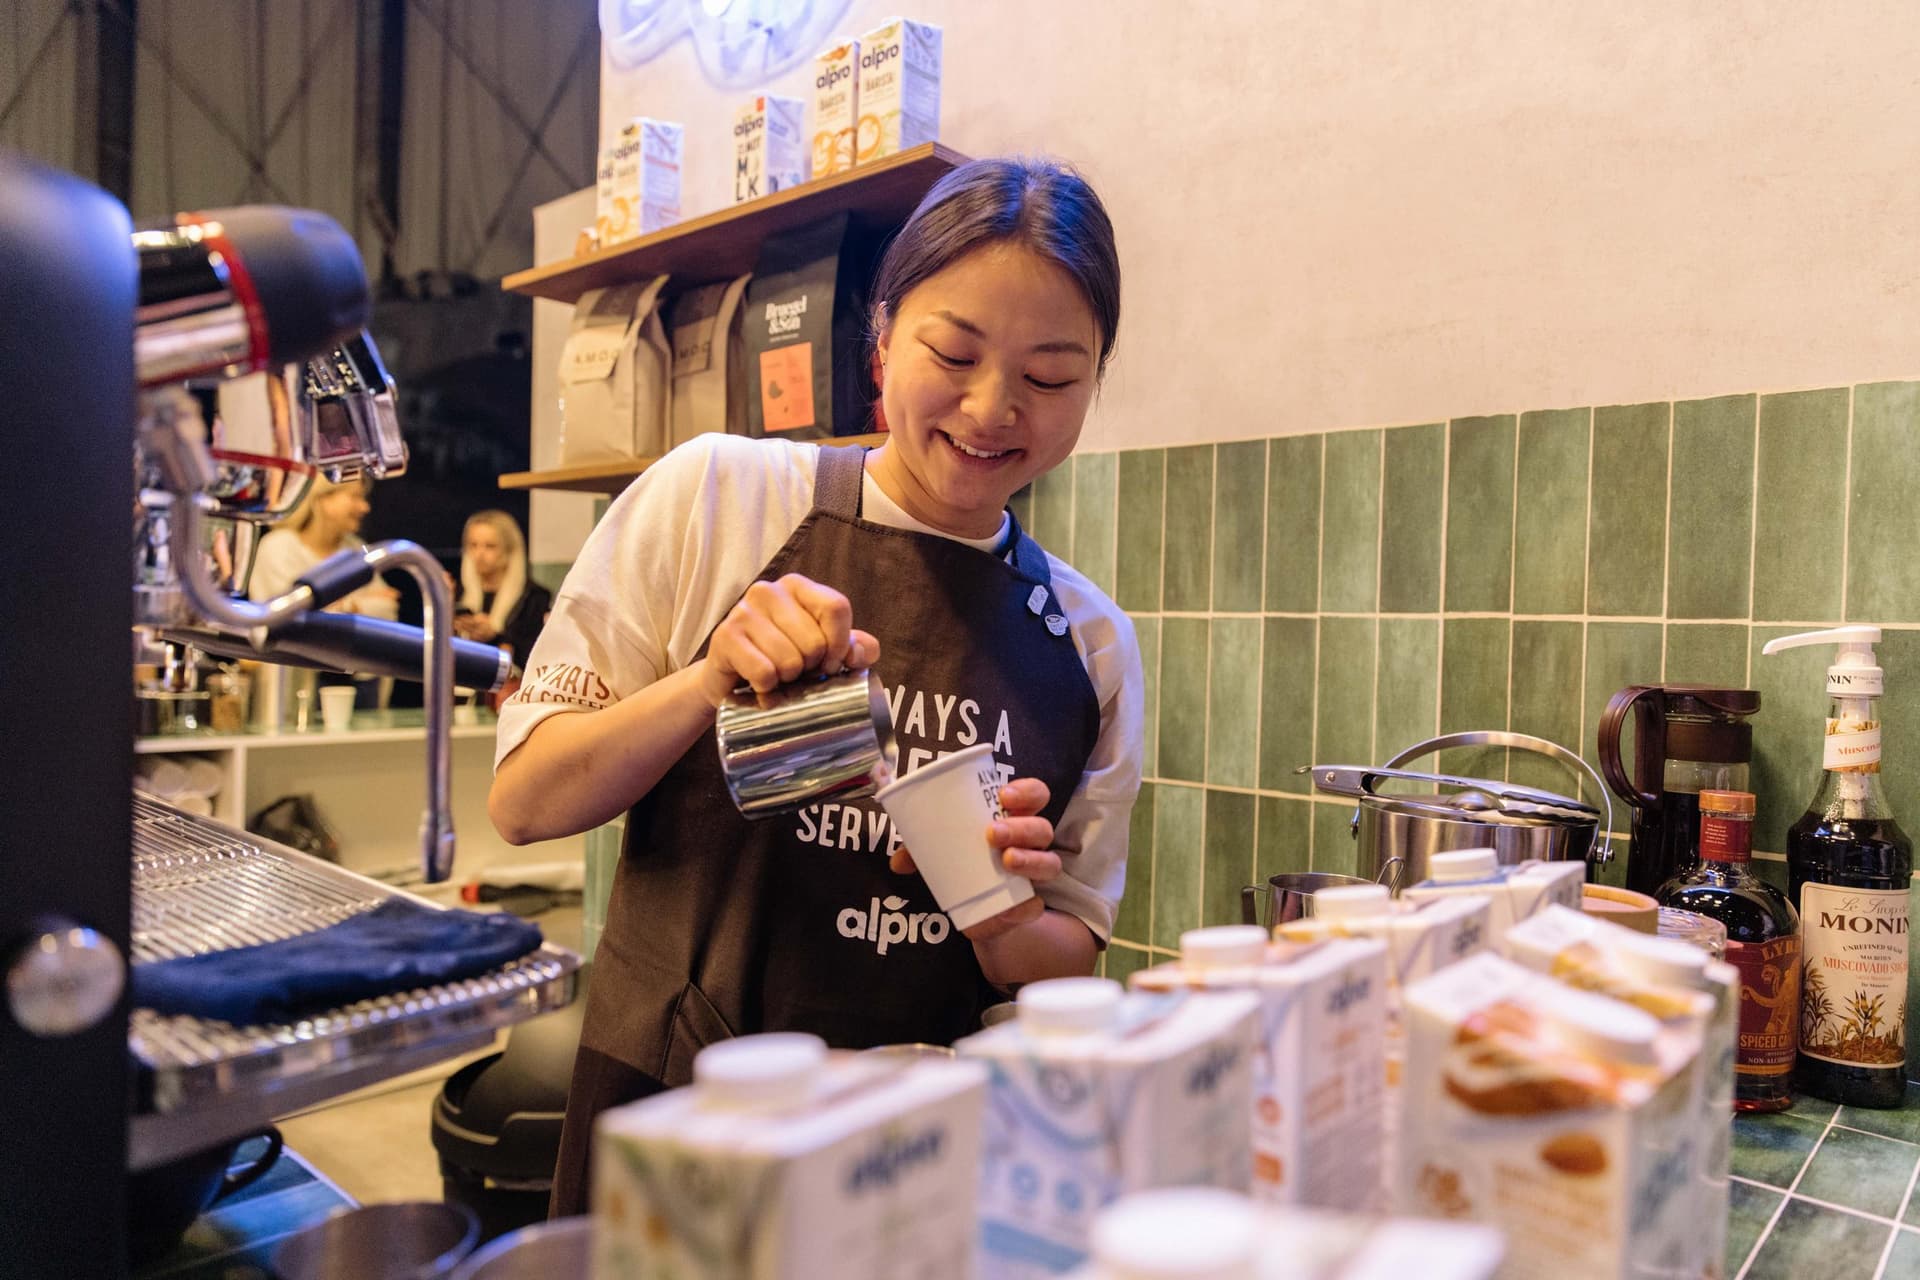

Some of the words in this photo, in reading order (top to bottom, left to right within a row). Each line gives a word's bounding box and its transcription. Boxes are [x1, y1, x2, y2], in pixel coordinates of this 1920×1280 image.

[861, 43, 899, 70] alpro
[816, 65, 851, 89] alpro
[994, 709, 1012, 756] A
[836, 896, 950, 956] alpro
[1740, 1034, 1777, 1048] SPICED
